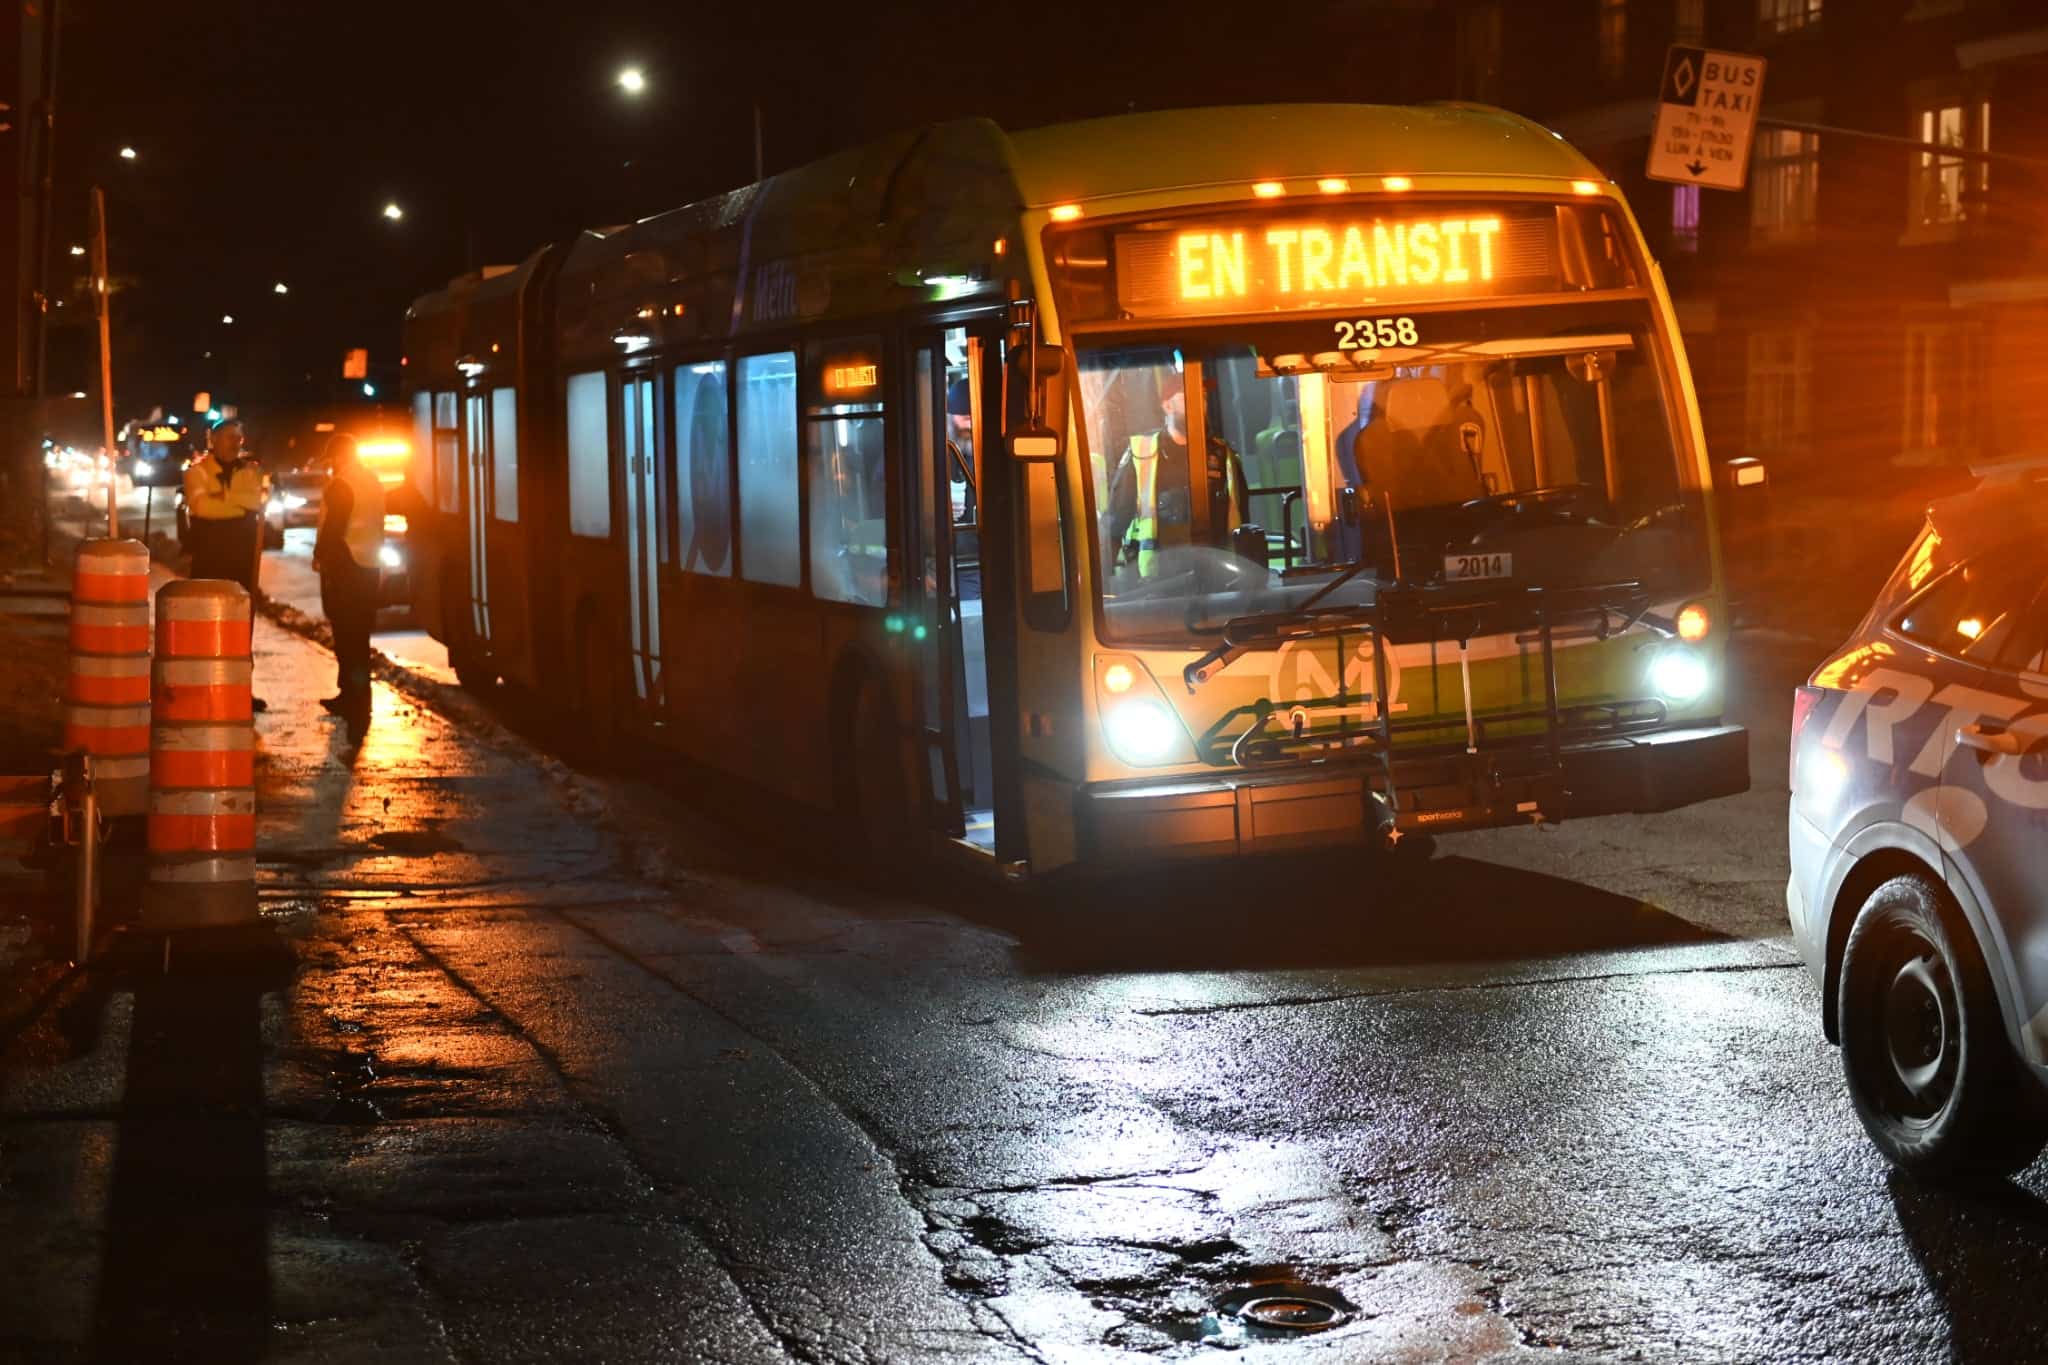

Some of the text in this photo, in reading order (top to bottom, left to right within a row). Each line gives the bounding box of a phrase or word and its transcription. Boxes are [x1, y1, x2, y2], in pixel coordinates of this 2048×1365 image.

[1705, 63, 1755, 87] BUS
[1704, 88, 1753, 112] TAXI
[1178, 217, 1501, 299] EN TRANSIT
[1334, 317, 1419, 350] 2358
[1458, 556, 1503, 577] 2014
